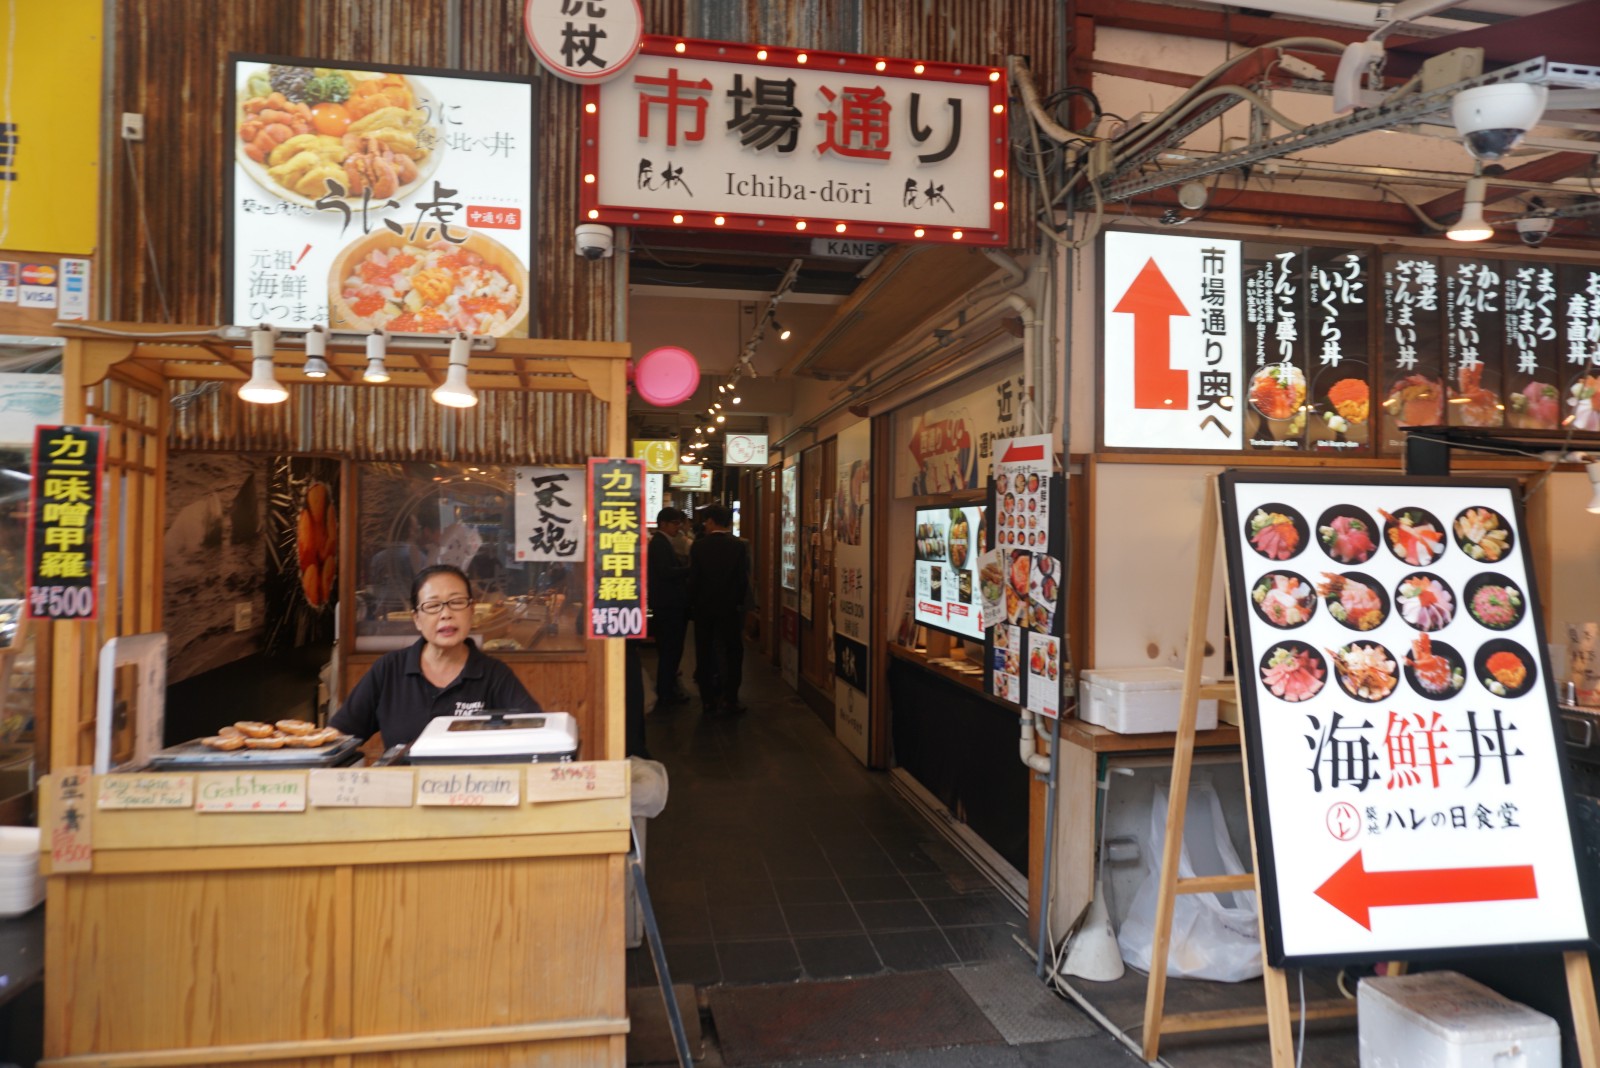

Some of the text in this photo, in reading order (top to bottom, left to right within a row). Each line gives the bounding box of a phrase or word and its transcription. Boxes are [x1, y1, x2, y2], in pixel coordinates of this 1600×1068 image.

[415, 97, 464, 127] うに
[633, 67, 963, 164] 市場通り
[415, 130, 516, 158] 食べ比べ丼
[315, 178, 470, 244] うに虎
[724, 172, 873, 206] Ichiba-dōri
[469, 210, 518, 225] 中通り店
[24, 291, 53, 302] VISA
[249, 271, 309, 299] 海鮮
[1341, 254, 1364, 304] うに
[1415, 261, 1439, 311] 海老
[1476, 264, 1500, 312] かに
[249, 301, 346, 323] ひつまぶし
[1274, 252, 1298, 386] てんこ盛り丼
[1319, 269, 1344, 368] いくら丼
[1394, 260, 1420, 371] ざんまい丼
[1456, 263, 1482, 372] ざんまい丼
[1516, 267, 1540, 375] ざんまい丼
[1536, 268, 1557, 341] まぐろ
[1566, 293, 1591, 366] 産直丼
[1197, 246, 1234, 439] 市場通り奥へ
[39, 434, 92, 578] カニ味噌甲羅
[598, 468, 639, 601] カニ味噌甲羅
[30, 586, 92, 616] ¥500
[592, 606, 643, 635] ¥500
[1304, 710, 1525, 793] 海鮮丼
[465, 772, 512, 794] brain
[1385, 802, 1521, 830] ハレの日食堂
